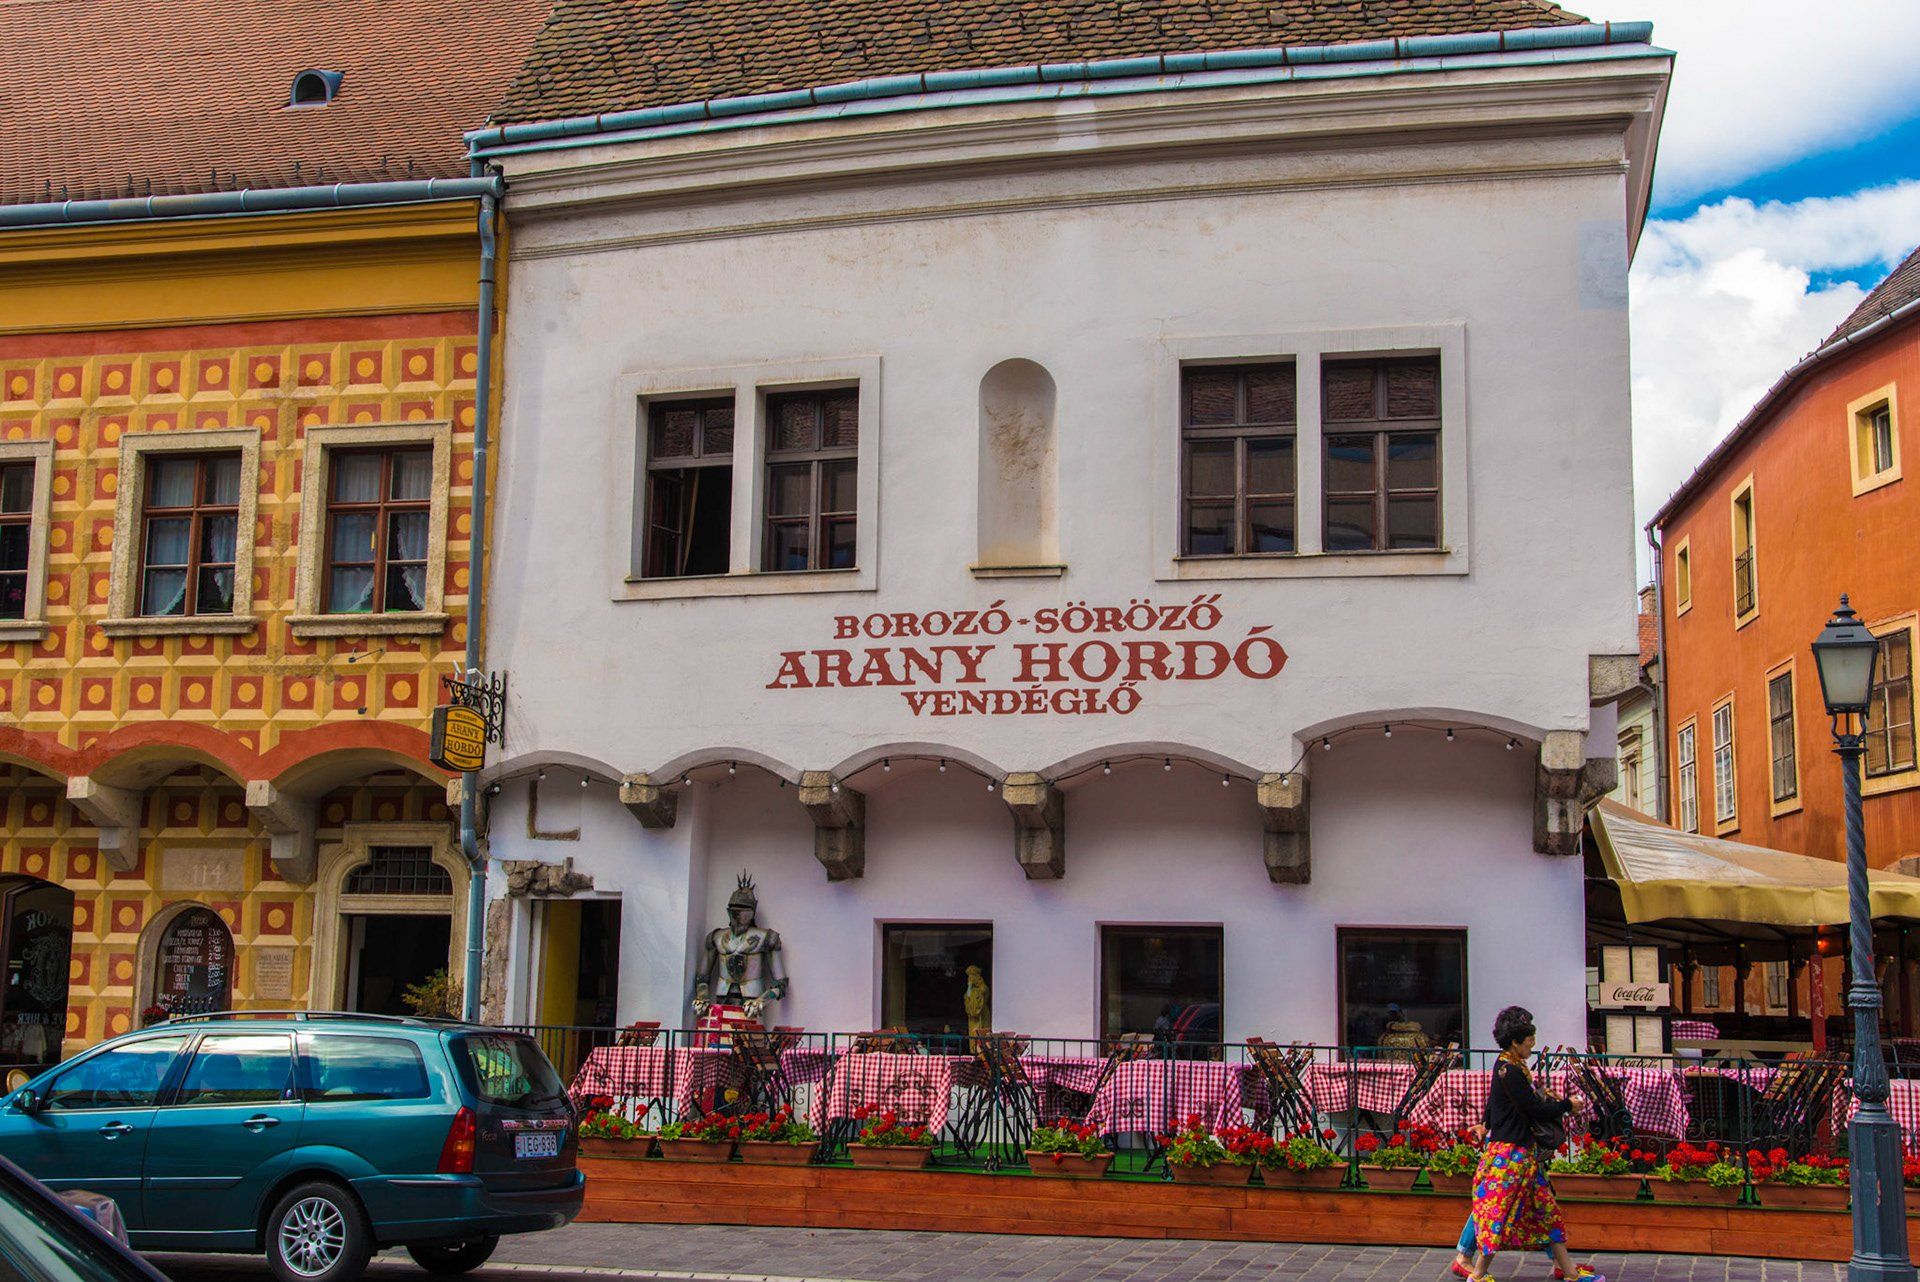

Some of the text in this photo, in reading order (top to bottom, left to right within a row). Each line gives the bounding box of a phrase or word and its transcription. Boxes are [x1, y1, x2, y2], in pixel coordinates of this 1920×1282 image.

[765, 624, 1290, 690] ARANY HORDÓ
[900, 681, 1143, 717] VENDÉGLŐ
[450, 723, 480, 740] ARANY
[447, 739, 481, 756] HORDÓ
[1612, 987, 1656, 1002] Coca-Cola
